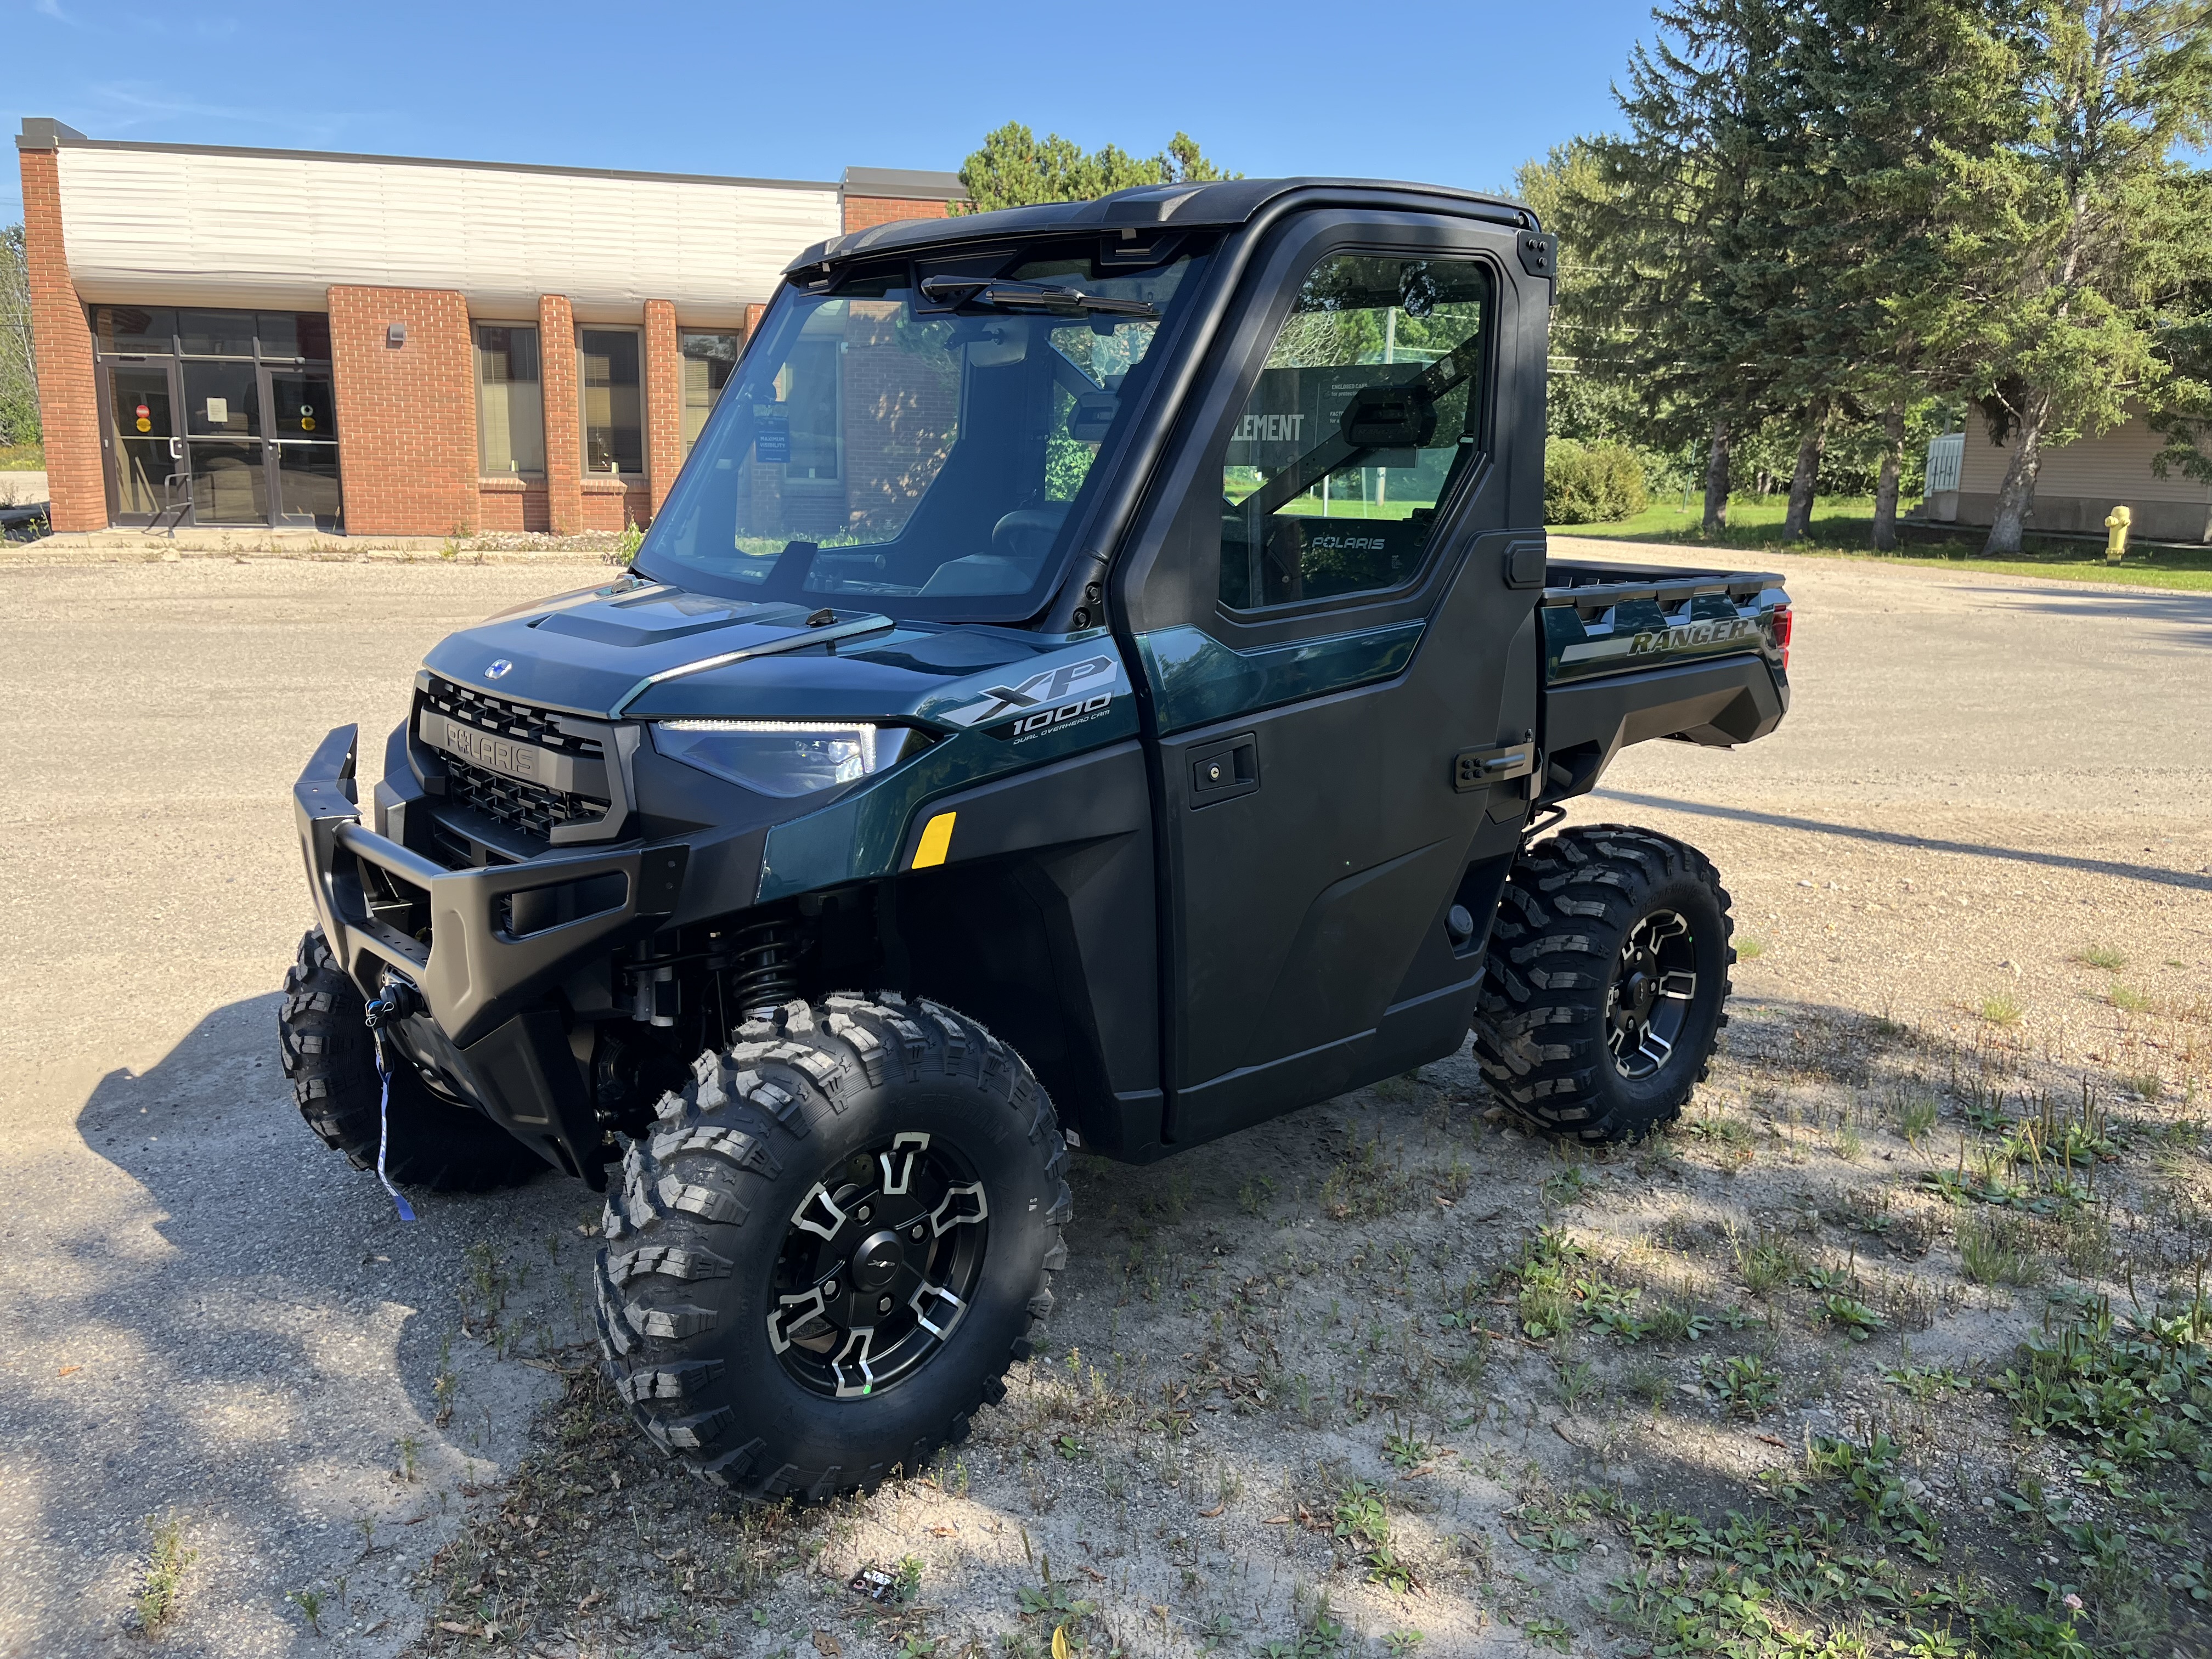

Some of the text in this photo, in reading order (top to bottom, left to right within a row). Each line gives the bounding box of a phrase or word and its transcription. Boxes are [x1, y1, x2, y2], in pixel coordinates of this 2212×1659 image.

[1231, 414, 1305, 441] LEMENT
[1312, 537, 1385, 550] POLARIS
[1626, 618, 1749, 657] RANGER
[970, 654, 1114, 723] XP
[1013, 692, 1111, 736] 1000
[1013, 709, 1110, 745] DUAL OVERHEAD CAM
[447, 724, 534, 776] POLARIS
[886, 1093, 1010, 1145] X-TERRAIN
